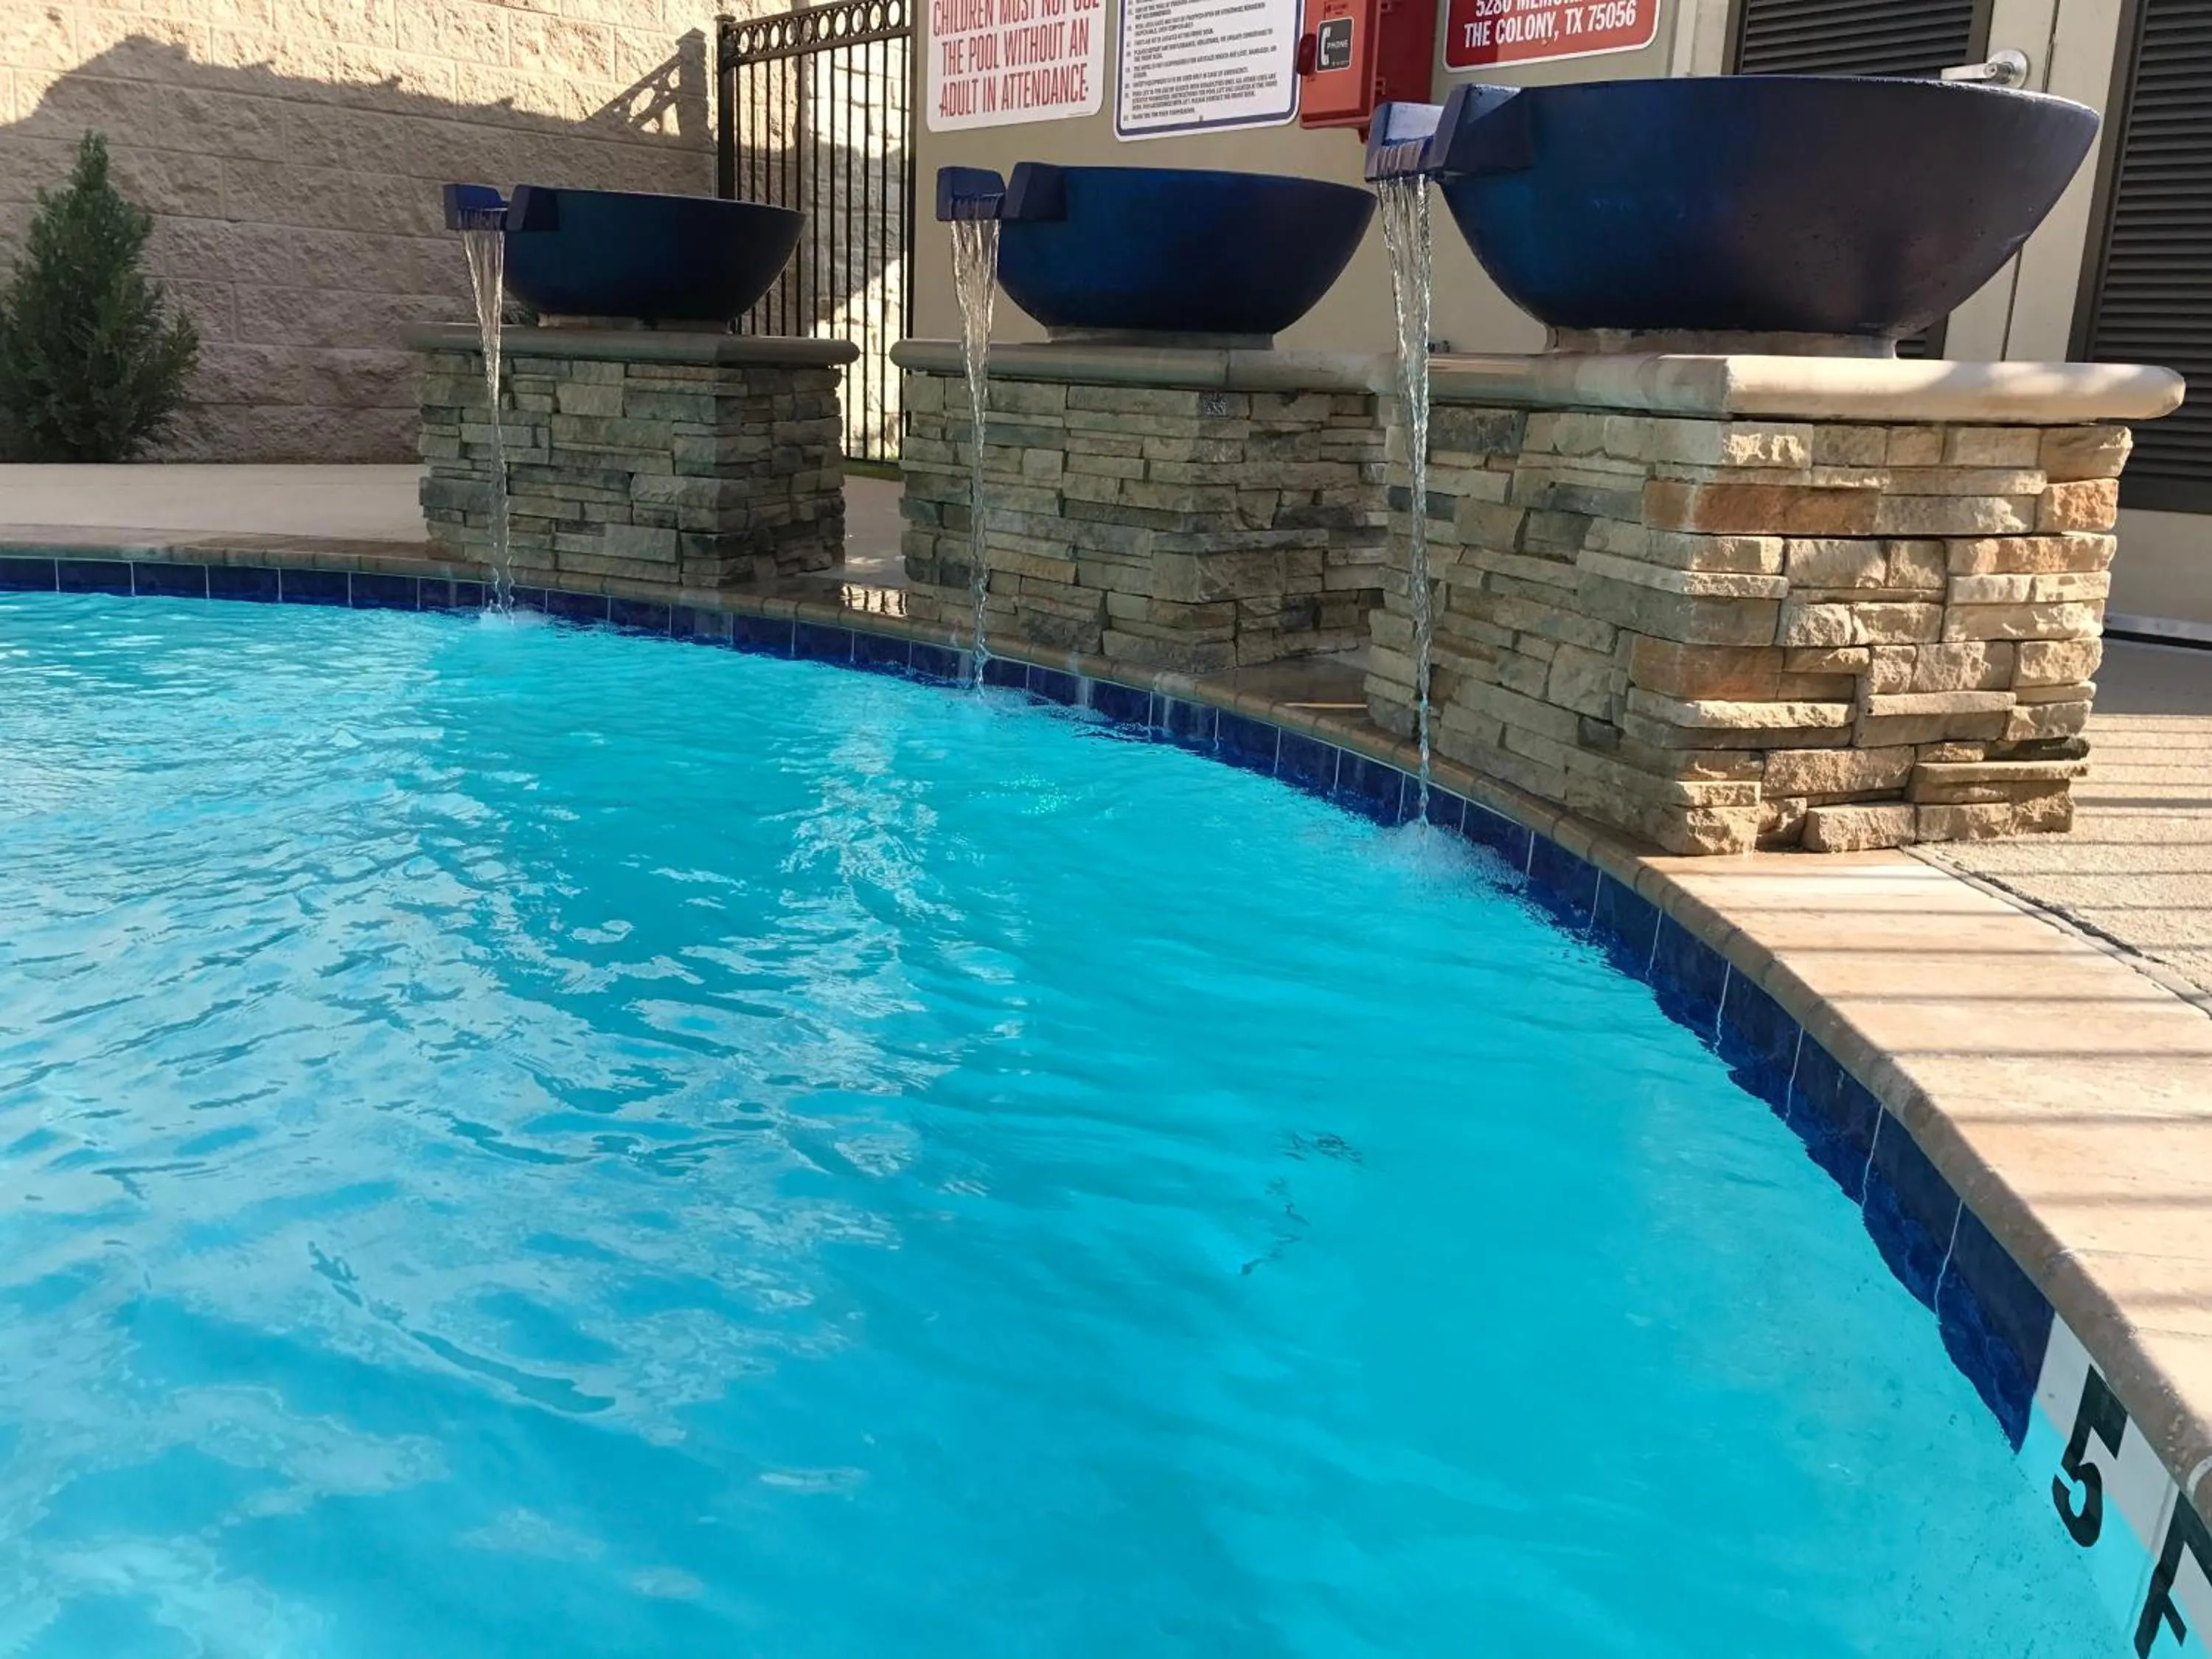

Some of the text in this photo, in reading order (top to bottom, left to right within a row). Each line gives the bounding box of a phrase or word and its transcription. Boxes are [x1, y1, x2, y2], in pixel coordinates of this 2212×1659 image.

[933, 0, 993, 36] CHILDREN
[1464, 1, 1637, 48] THE COLONY, TX 75056
[942, 40, 964, 77] THE
[969, 32, 999, 73] POOL
[1004, 22, 1065, 67] WITHOUT
[1069, 18, 1089, 57] AN
[940, 79, 978, 118] ADULT
[983, 75, 995, 113] IN
[2052, 1363, 2129, 1548] 5
